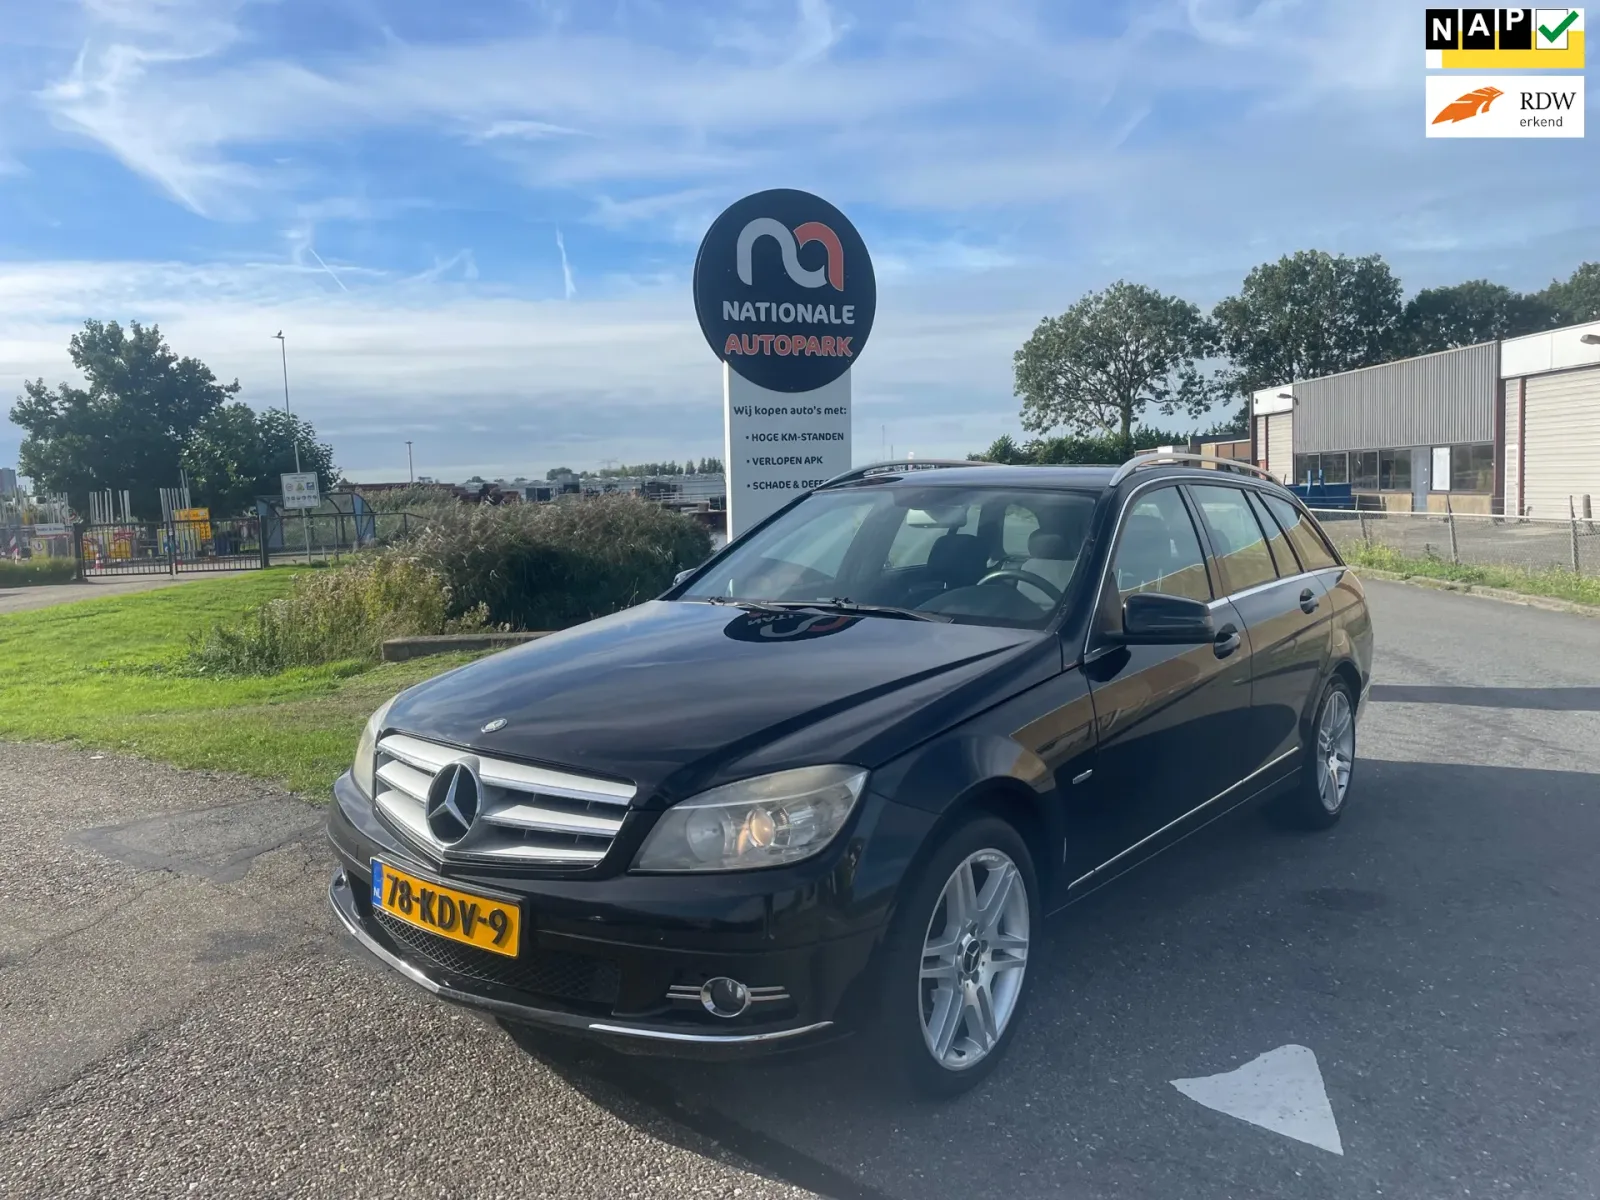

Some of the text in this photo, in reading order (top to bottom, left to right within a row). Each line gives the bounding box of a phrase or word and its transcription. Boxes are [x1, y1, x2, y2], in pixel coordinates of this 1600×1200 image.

[722, 300, 855, 325] NATIONALE
[724, 333, 853, 357] AUTOPARK
[733, 405, 847, 417] Wij kopen auto's met:
[751, 432, 844, 442] HOGE KM-STANDEN
[752, 456, 823, 466] VERLOPEN APK
[752, 480, 791, 490] SCHADE
[793, 480, 800, 489] &
[386, 873, 508, 945] 78-KDV-9
